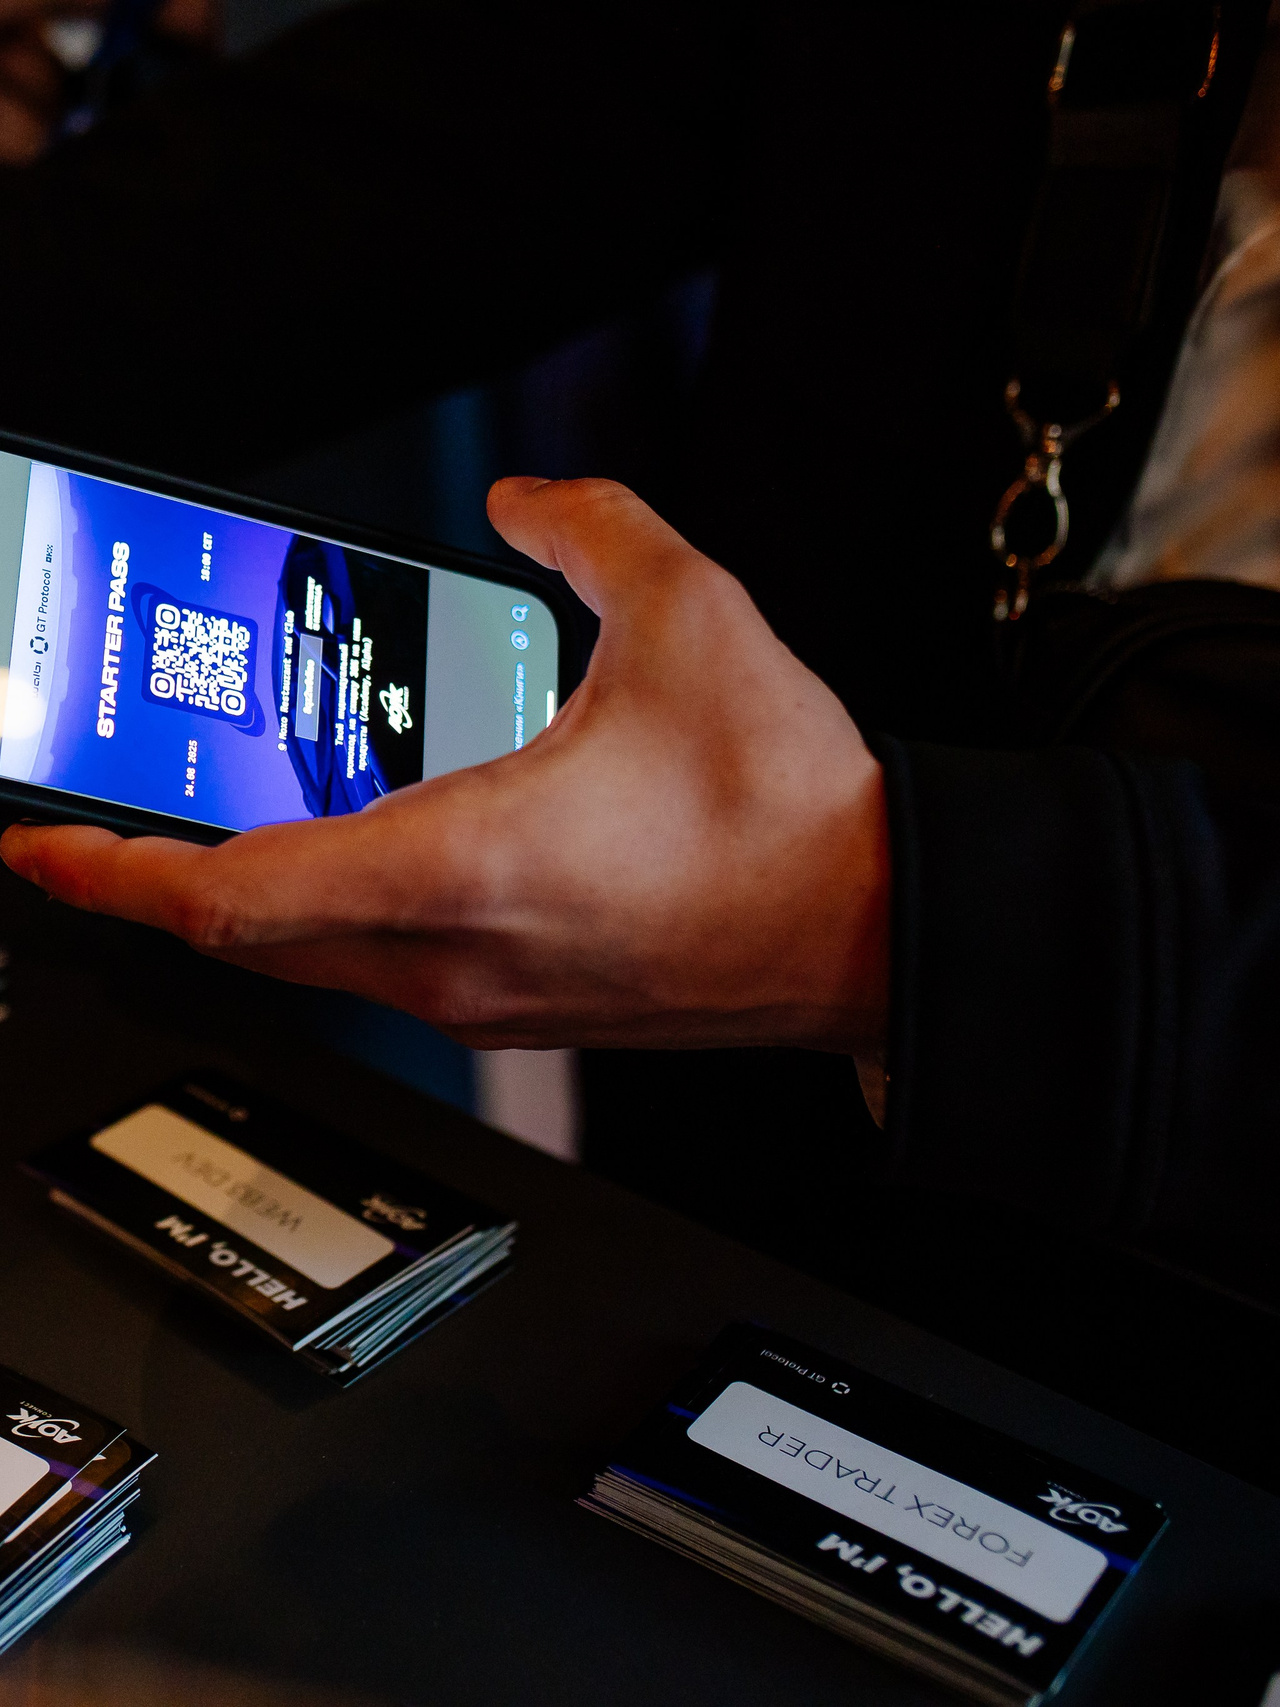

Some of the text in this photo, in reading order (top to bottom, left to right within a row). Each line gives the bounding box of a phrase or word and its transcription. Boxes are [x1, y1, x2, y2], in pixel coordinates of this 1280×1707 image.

[36, 568, 52, 633] GT Protocol
[284, 610, 295, 634] Club
[96, 541, 130, 739] STARTER PASS
[283, 636, 293, 656] and
[280, 658, 292, 713] Restaurant
[187, 739, 198, 764] 2025
[154, 1214, 309, 1311] HELLO, I'M
[760, 1349, 826, 1384] GT Protocol
[758, 1425, 1034, 1567] FOREX TRADER
[817, 1532, 1046, 1658] HELLO, I'M
